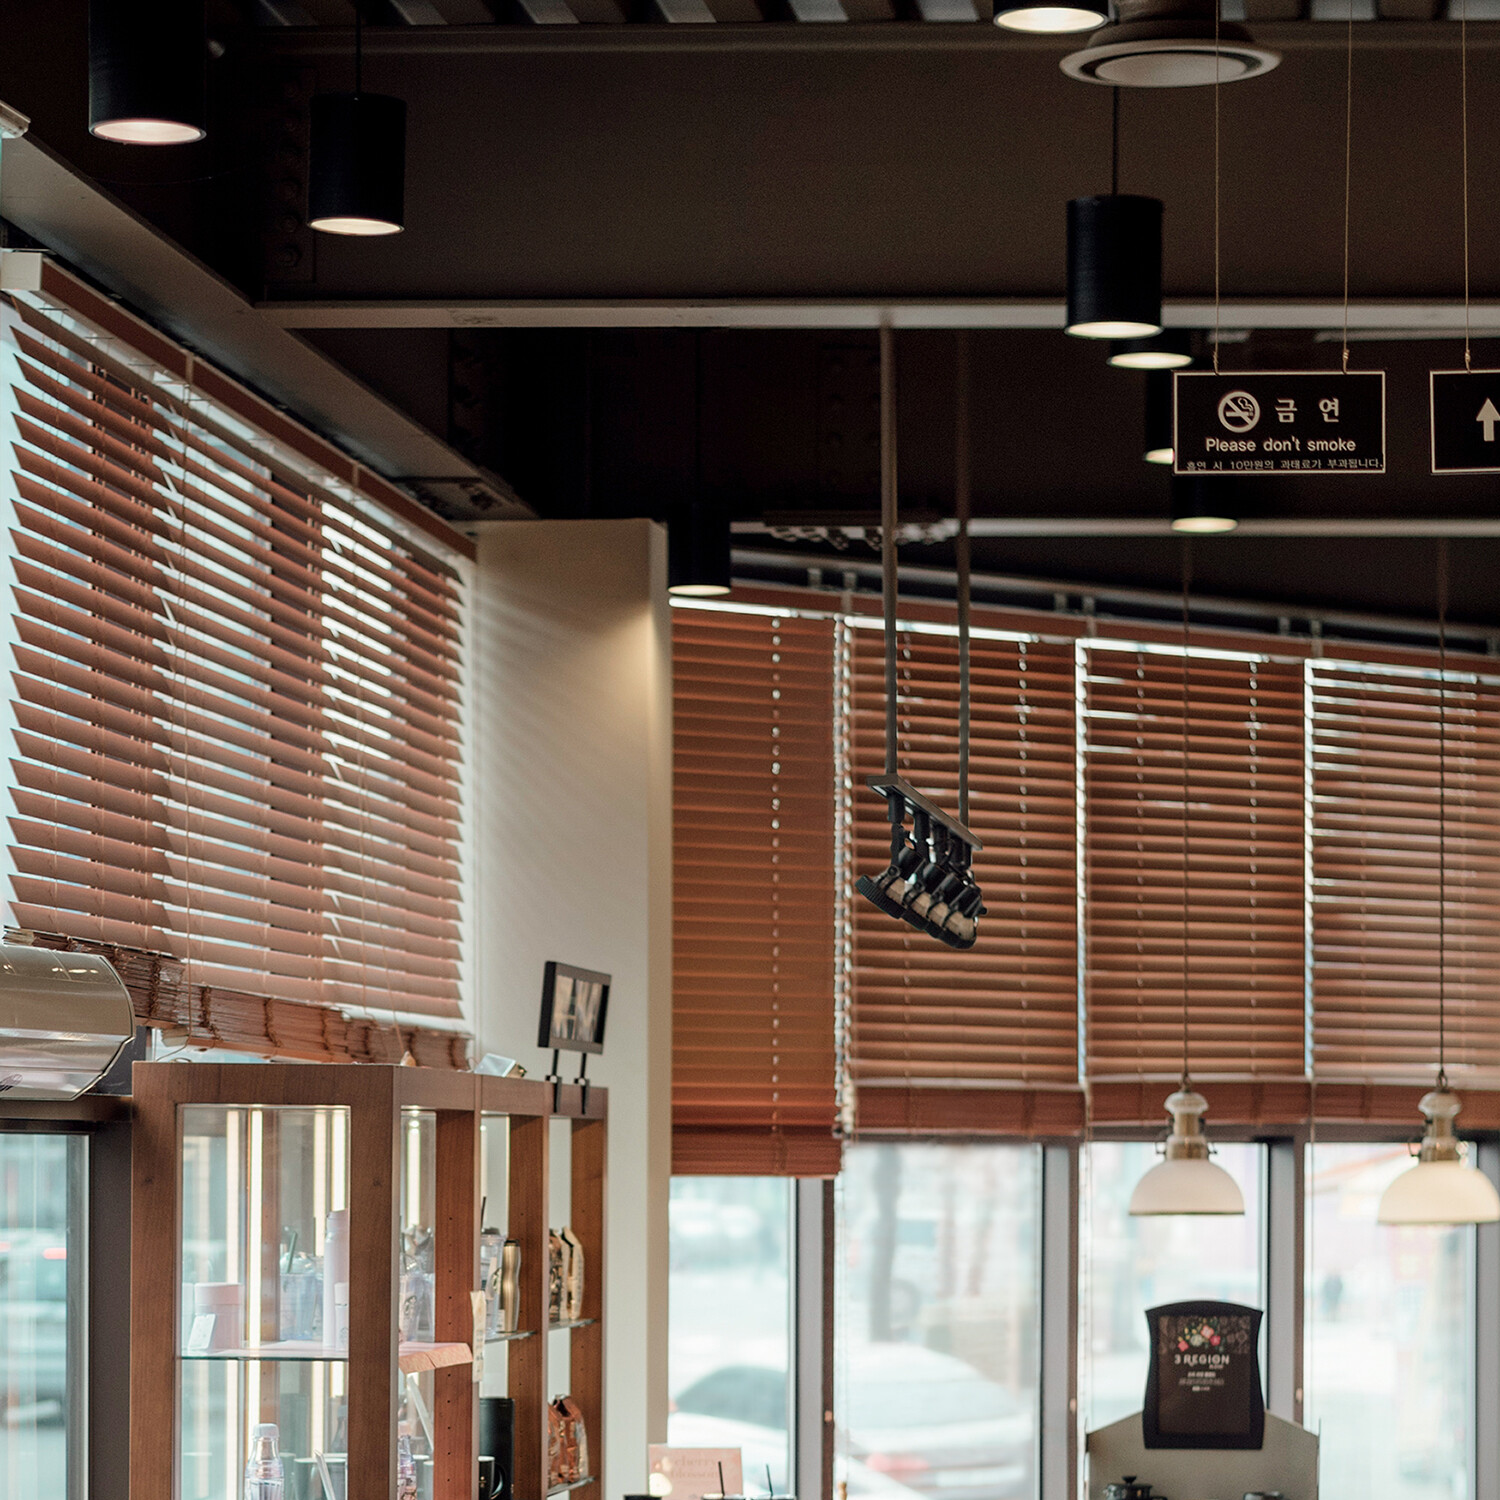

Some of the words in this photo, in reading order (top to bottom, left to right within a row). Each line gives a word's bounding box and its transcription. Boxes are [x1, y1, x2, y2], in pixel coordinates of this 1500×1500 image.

[1205, 437, 1256, 452] Please
[1263, 436, 1301, 452] don't
[1307, 437, 1356, 452] smoke
[1212, 461, 1223, 470] 시
[1230, 460, 1275, 471] 10만원의
[1280, 459, 1322, 470] 과태료가
[1183, 1353, 1230, 1367] REGION
